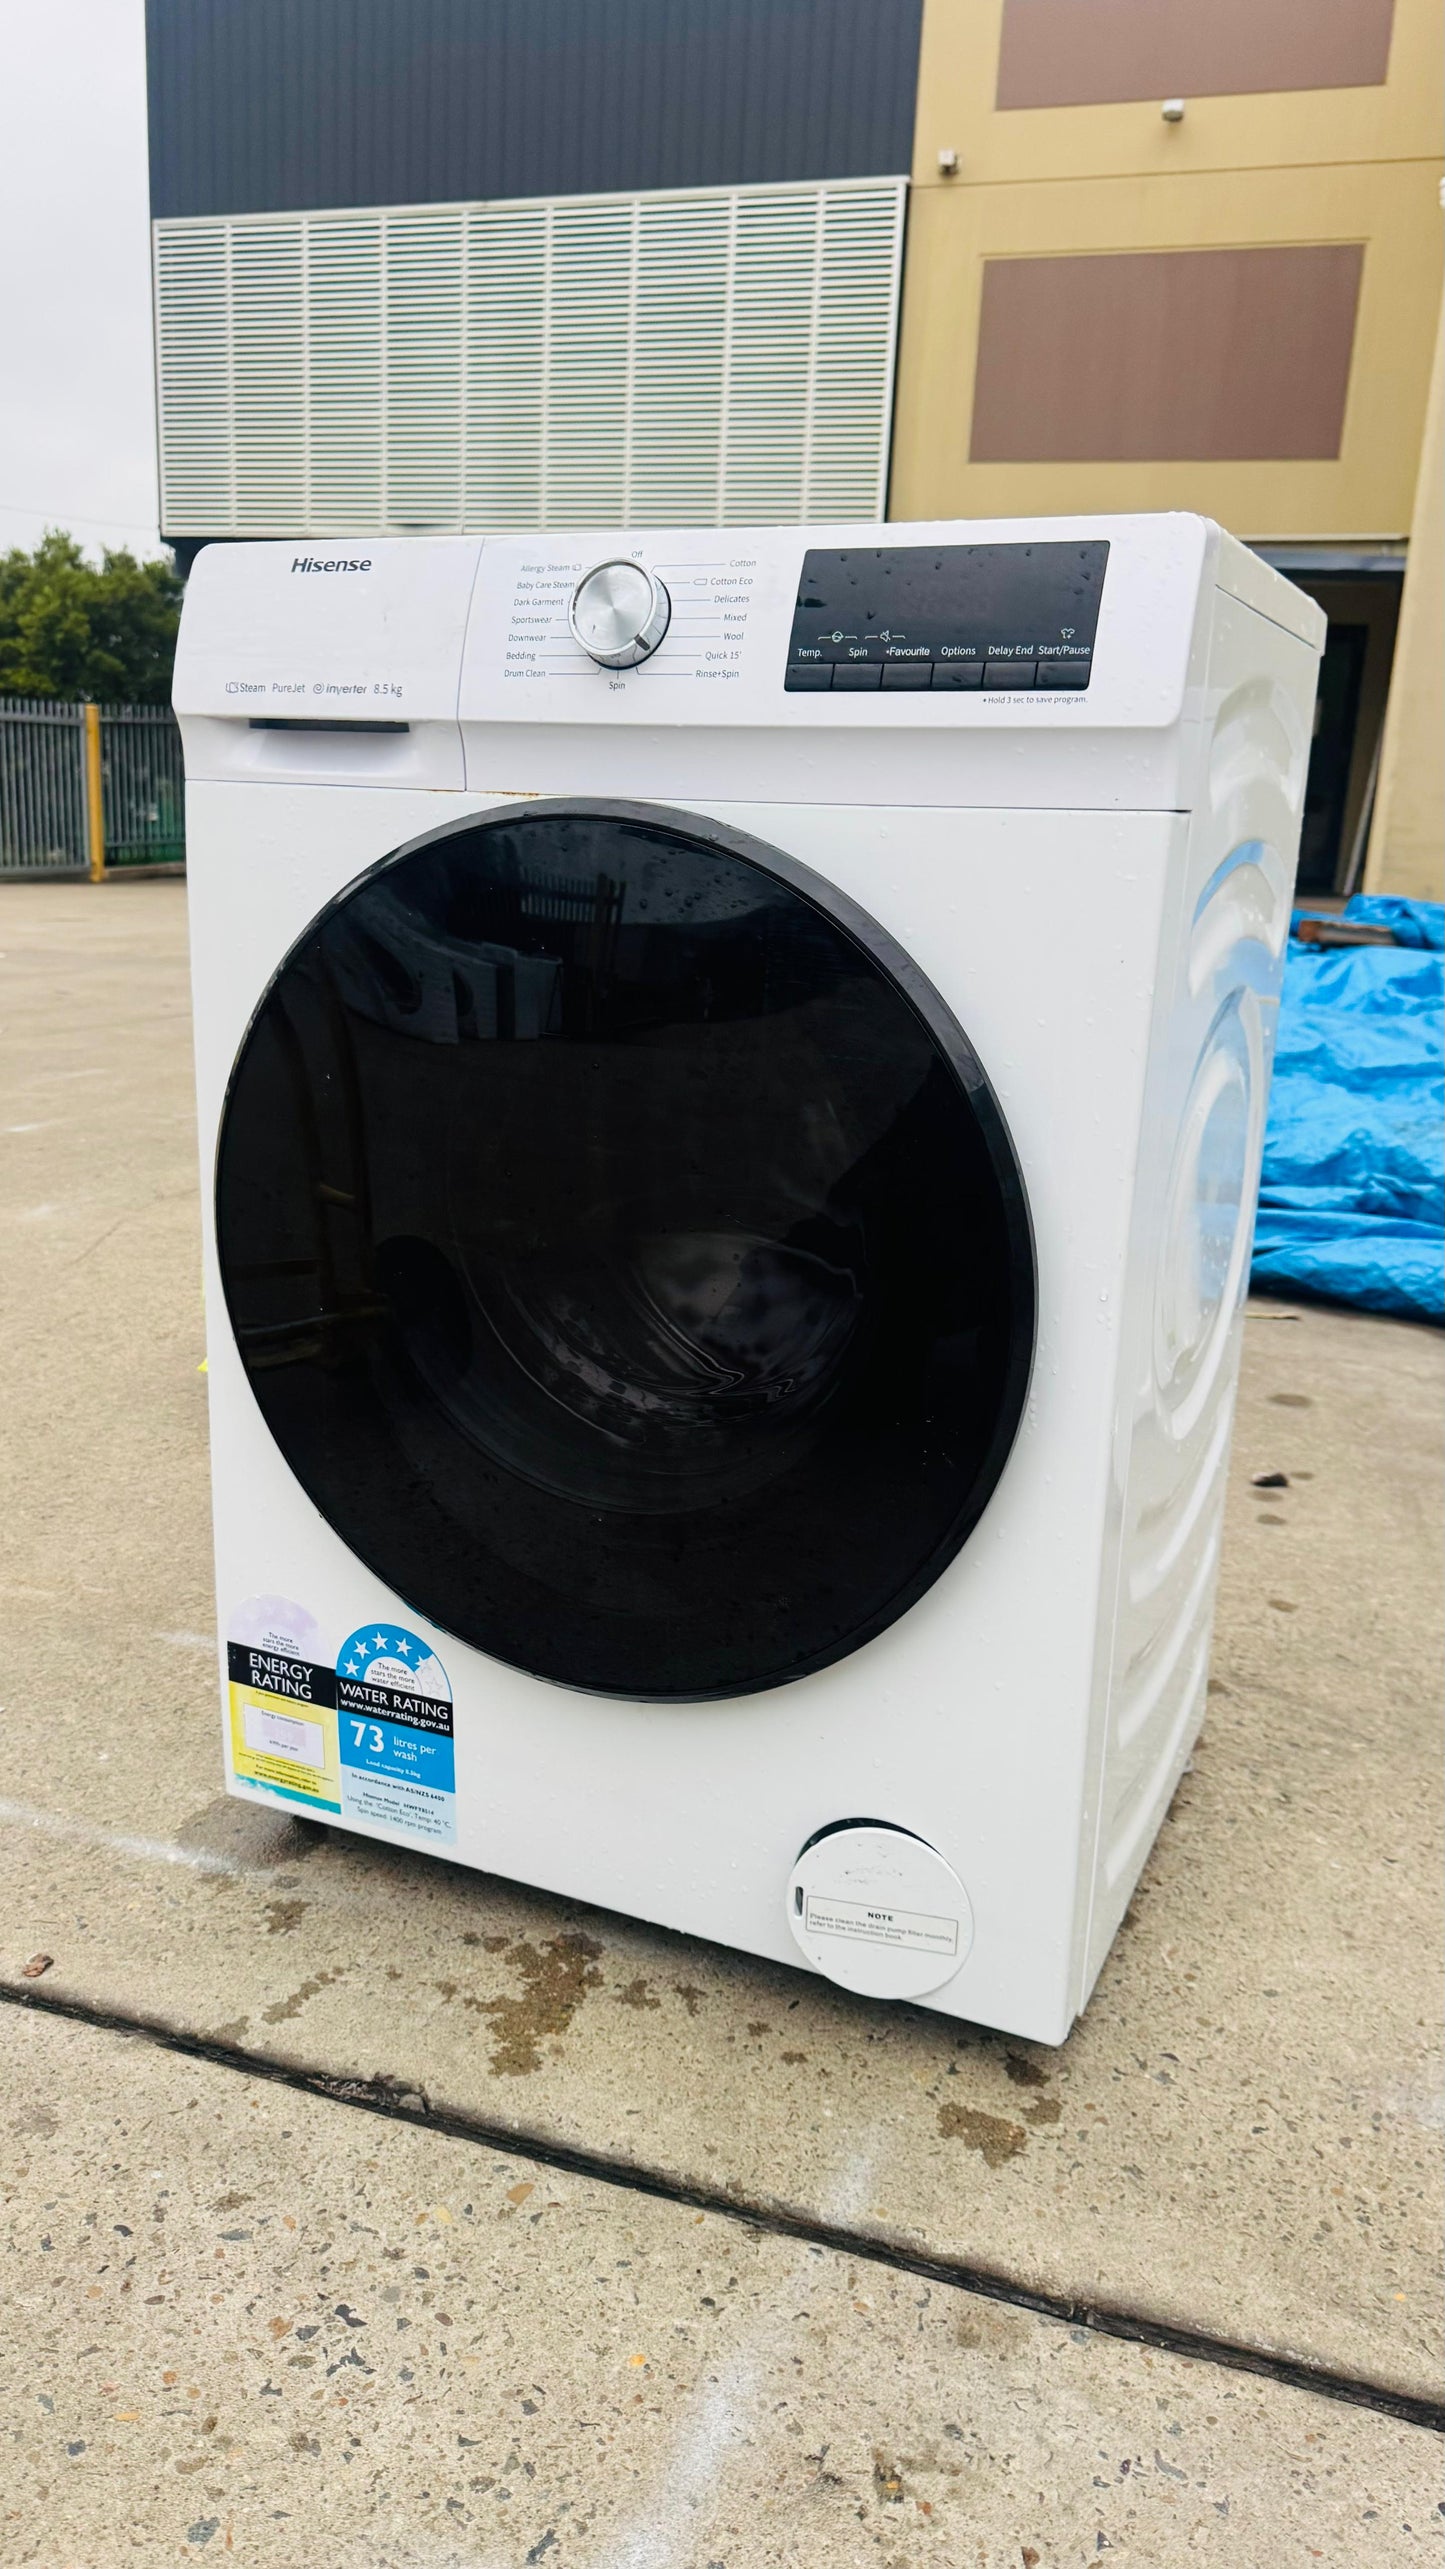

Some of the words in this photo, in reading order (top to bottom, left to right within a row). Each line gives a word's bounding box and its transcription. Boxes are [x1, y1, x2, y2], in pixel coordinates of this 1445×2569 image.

[632, 550, 642, 558] Off
[291, 558, 372, 573] Hisense
[520, 564, 545, 574] Allergy
[547, 564, 570, 572] Steam
[516, 582, 534, 590] Baby
[710, 577, 737, 586] Cotton
[514, 598, 530, 606] Dark
[532, 598, 564, 606] Garment
[714, 595, 750, 603] Delicates
[512, 616, 552, 625] Sportswear
[724, 614, 747, 622] Mixed
[508, 634, 546, 642] Downwear
[724, 632, 744, 640] Wool
[798, 648, 822, 658] Temp.
[848, 648, 868, 658] Spin
[941, 646, 976, 656] Options
[988, 646, 1014, 657] Delay
[1015, 645, 1034, 654] End
[1038, 645, 1091, 656] Start/Pause
[506, 652, 536, 661] Bedding
[705, 652, 728, 661] Quick
[504, 669, 524, 678] Drum
[526, 669, 546, 678] Clean
[696, 670, 740, 680] Rinse+Spin
[240, 682, 266, 693] Steam
[272, 682, 306, 693] PureJet
[326, 684, 367, 696] inverter
[374, 684, 388, 694] 8.5
[390, 684, 403, 698] kg
[608, 682, 626, 691] Spin
[988, 696, 1006, 704] Hold
[1006, 696, 1012, 704] 3
[1026, 696, 1034, 704] to
[249, 1652, 313, 1682] ENERGY
[378, 1662, 389, 1670] The
[391, 1666, 408, 1675] more
[370, 1669, 386, 1678] stars
[398, 1676, 415, 1684] more
[252, 1669, 312, 1700] RATING
[372, 1676, 389, 1685] water
[390, 1680, 415, 1691] efficient
[340, 1682, 388, 1706] WATER
[393, 1694, 448, 1720] RATING
[340, 1698, 450, 1732] www.waterrating.gov.au
[350, 1720, 384, 1753] 73
[394, 1736, 418, 1750] litres
[420, 1744, 436, 1754] per
[393, 1750, 418, 1762] wash
[366, 1759, 380, 1768] Load
[358, 1776, 391, 1788] accordance
[347, 1795, 362, 1806] Using
[357, 1806, 369, 1815] Spin
[404, 1820, 416, 1828] rpm
[868, 1912, 894, 1922] NOTE
[810, 1912, 834, 1922] Please
[856, 1920, 866, 1928] the
[887, 1926, 906, 1935] pump
